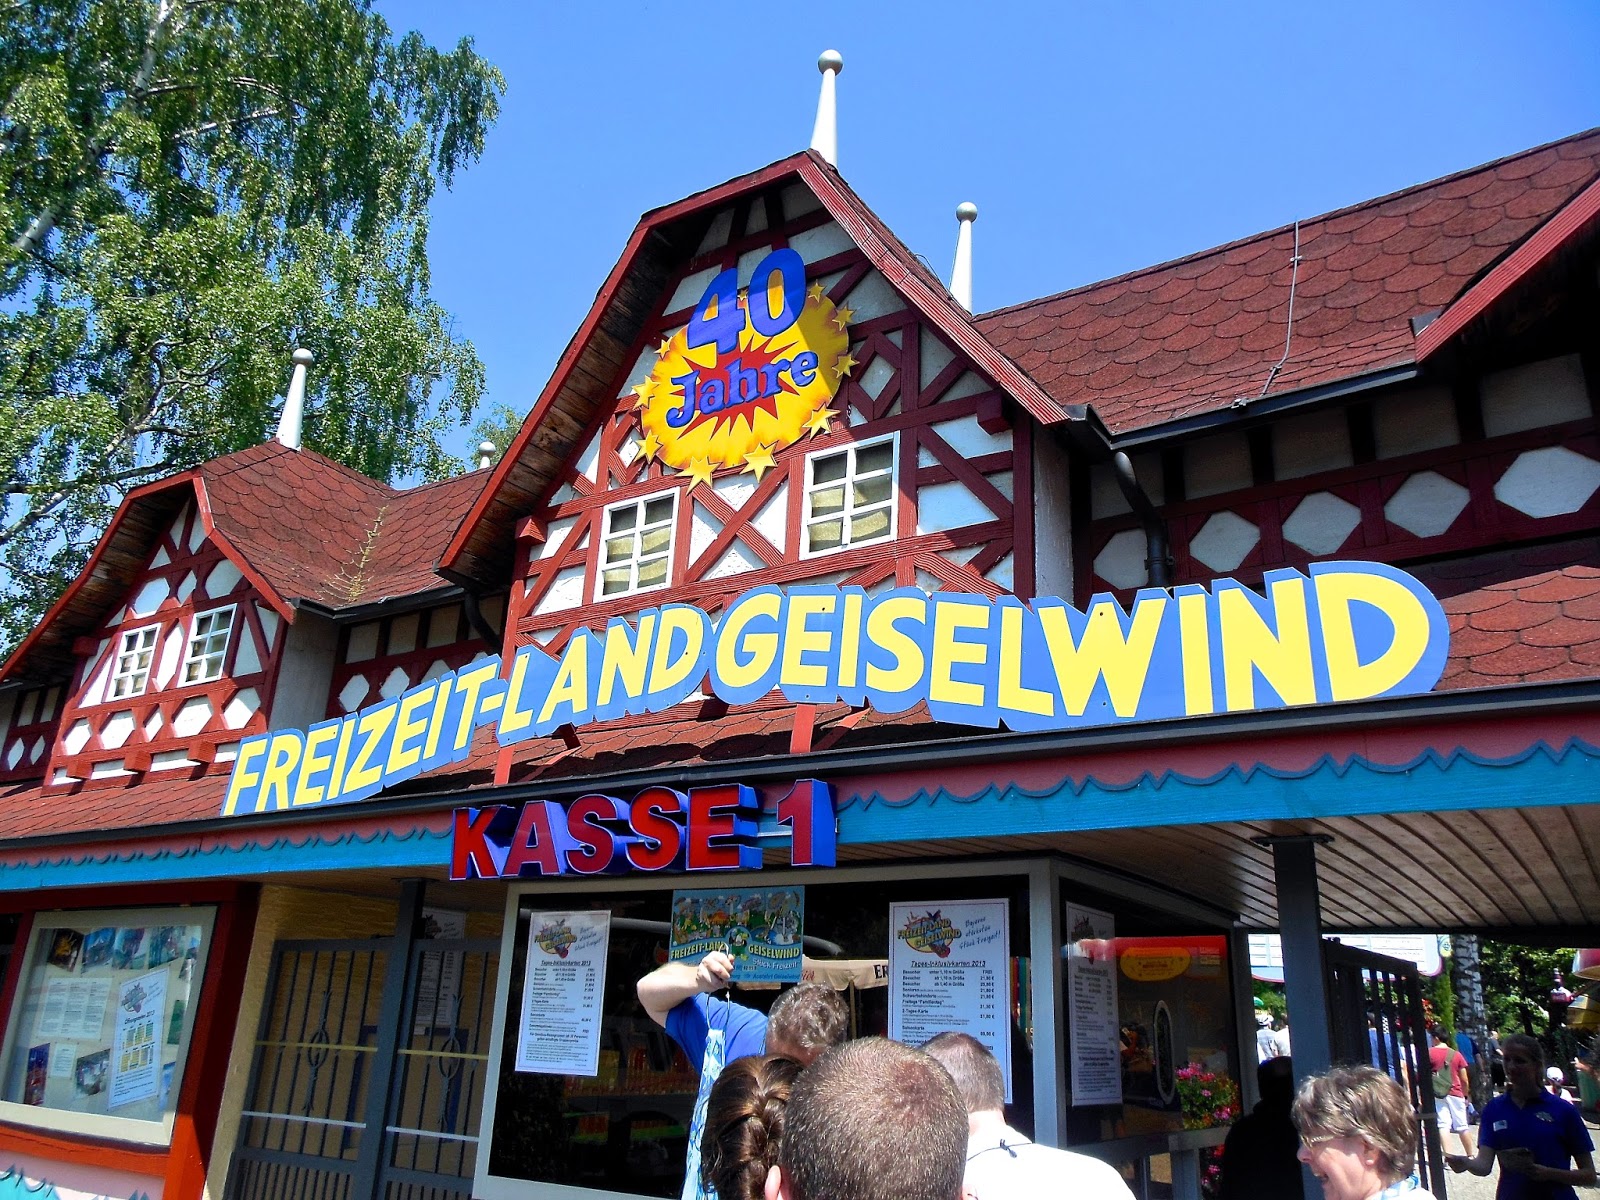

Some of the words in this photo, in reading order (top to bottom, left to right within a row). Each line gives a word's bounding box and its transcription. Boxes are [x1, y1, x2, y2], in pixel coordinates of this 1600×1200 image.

[686, 248, 806, 354] 40
[665, 351, 819, 429] Jahre
[222, 608, 705, 817] FREIZEIT-LAND
[715, 571, 1431, 718] GEISELWIND
[450, 781, 761, 881] KASSE
[776, 779, 836, 868] 1
[748, 943, 800, 960] GEISELWIND
